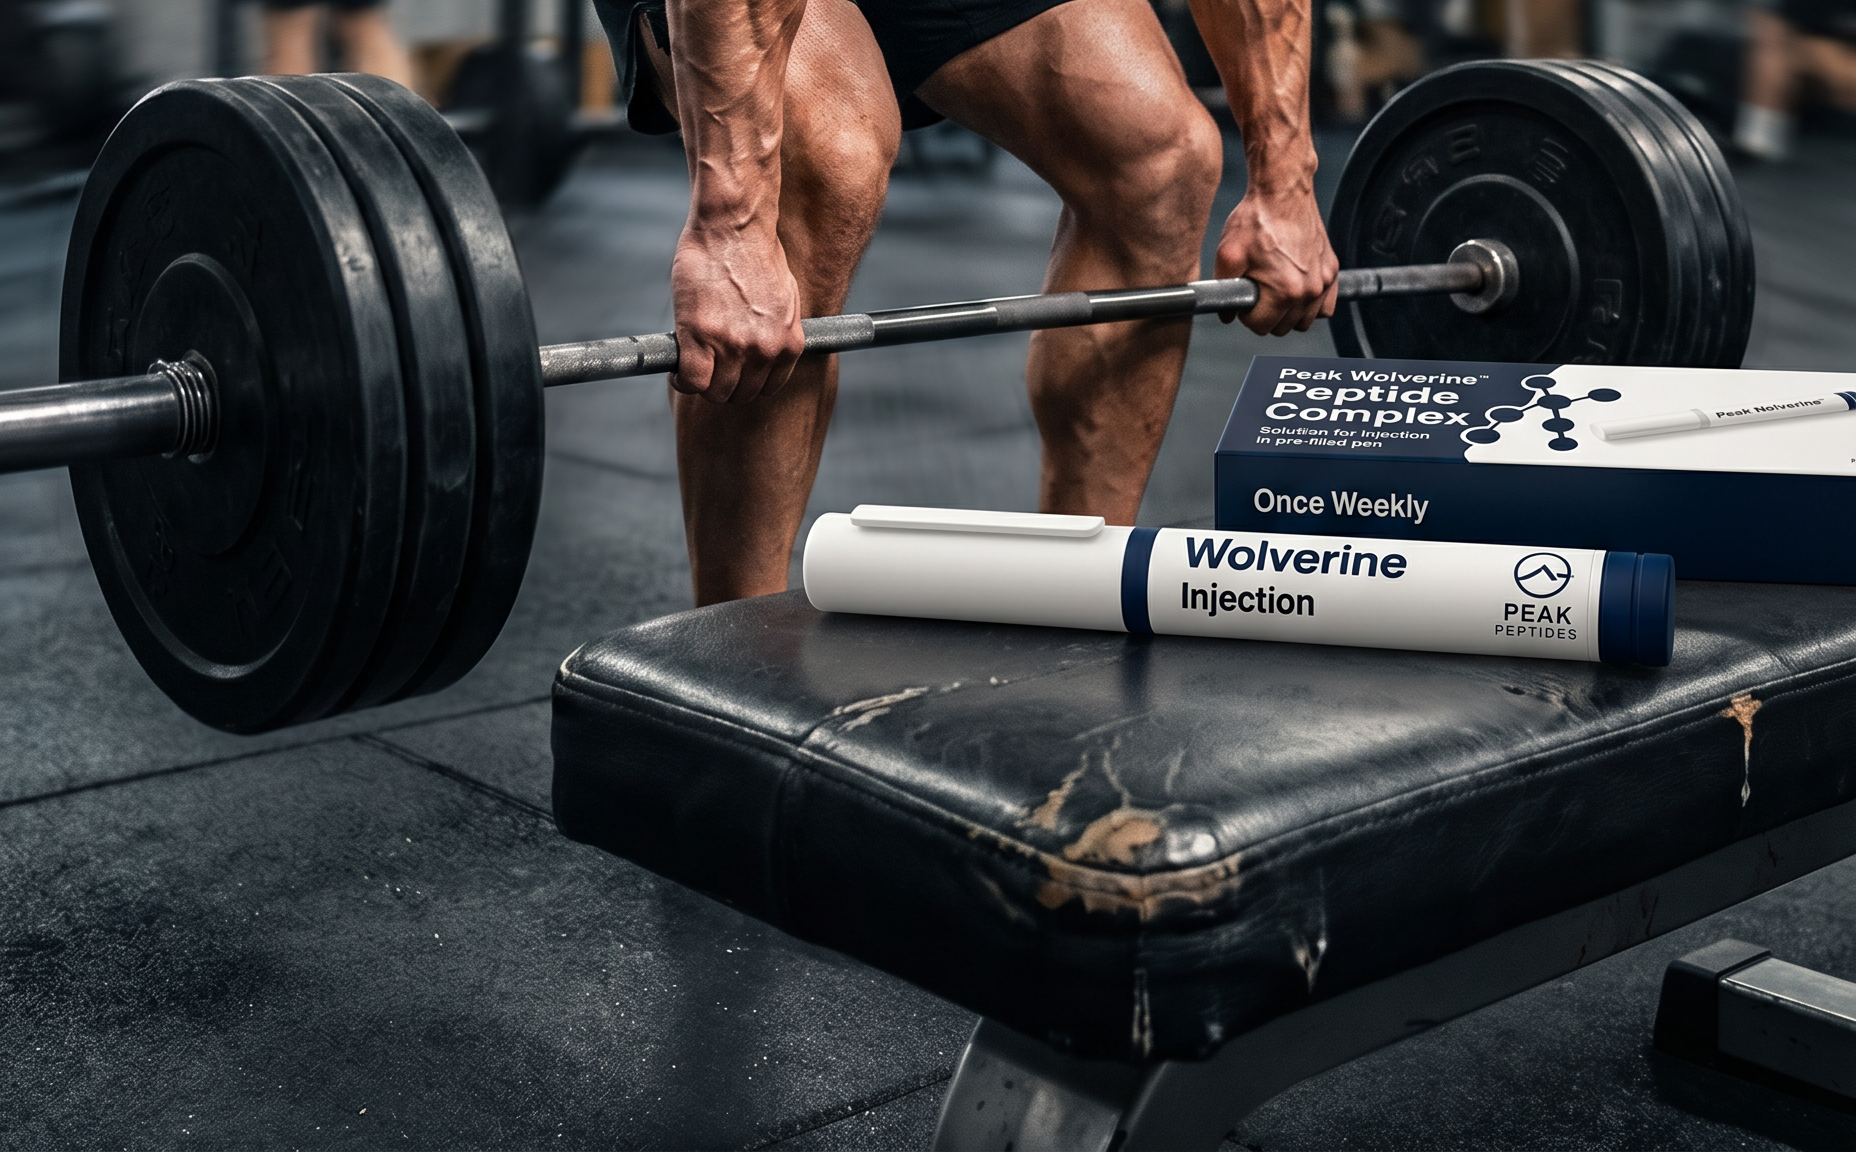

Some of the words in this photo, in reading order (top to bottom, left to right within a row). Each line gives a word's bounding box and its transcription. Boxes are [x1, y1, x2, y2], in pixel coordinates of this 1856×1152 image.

[1279, 368, 1343, 381] Peak
[1273, 382, 1460, 405] Peptide
[1265, 402, 1470, 427] Complex
[1716, 408, 1751, 418] Peak
[1333, 428, 1357, 437] for
[1351, 440, 1383, 449] pen
[1253, 488, 1325, 515] Once
[1331, 491, 1429, 524] Weekly
[1185, 536, 1407, 579] Wolverine
[1181, 582, 1315, 616] Injection
[1504, 603, 1572, 625] PEAK
[1495, 624, 1577, 640] PEPTIDES
